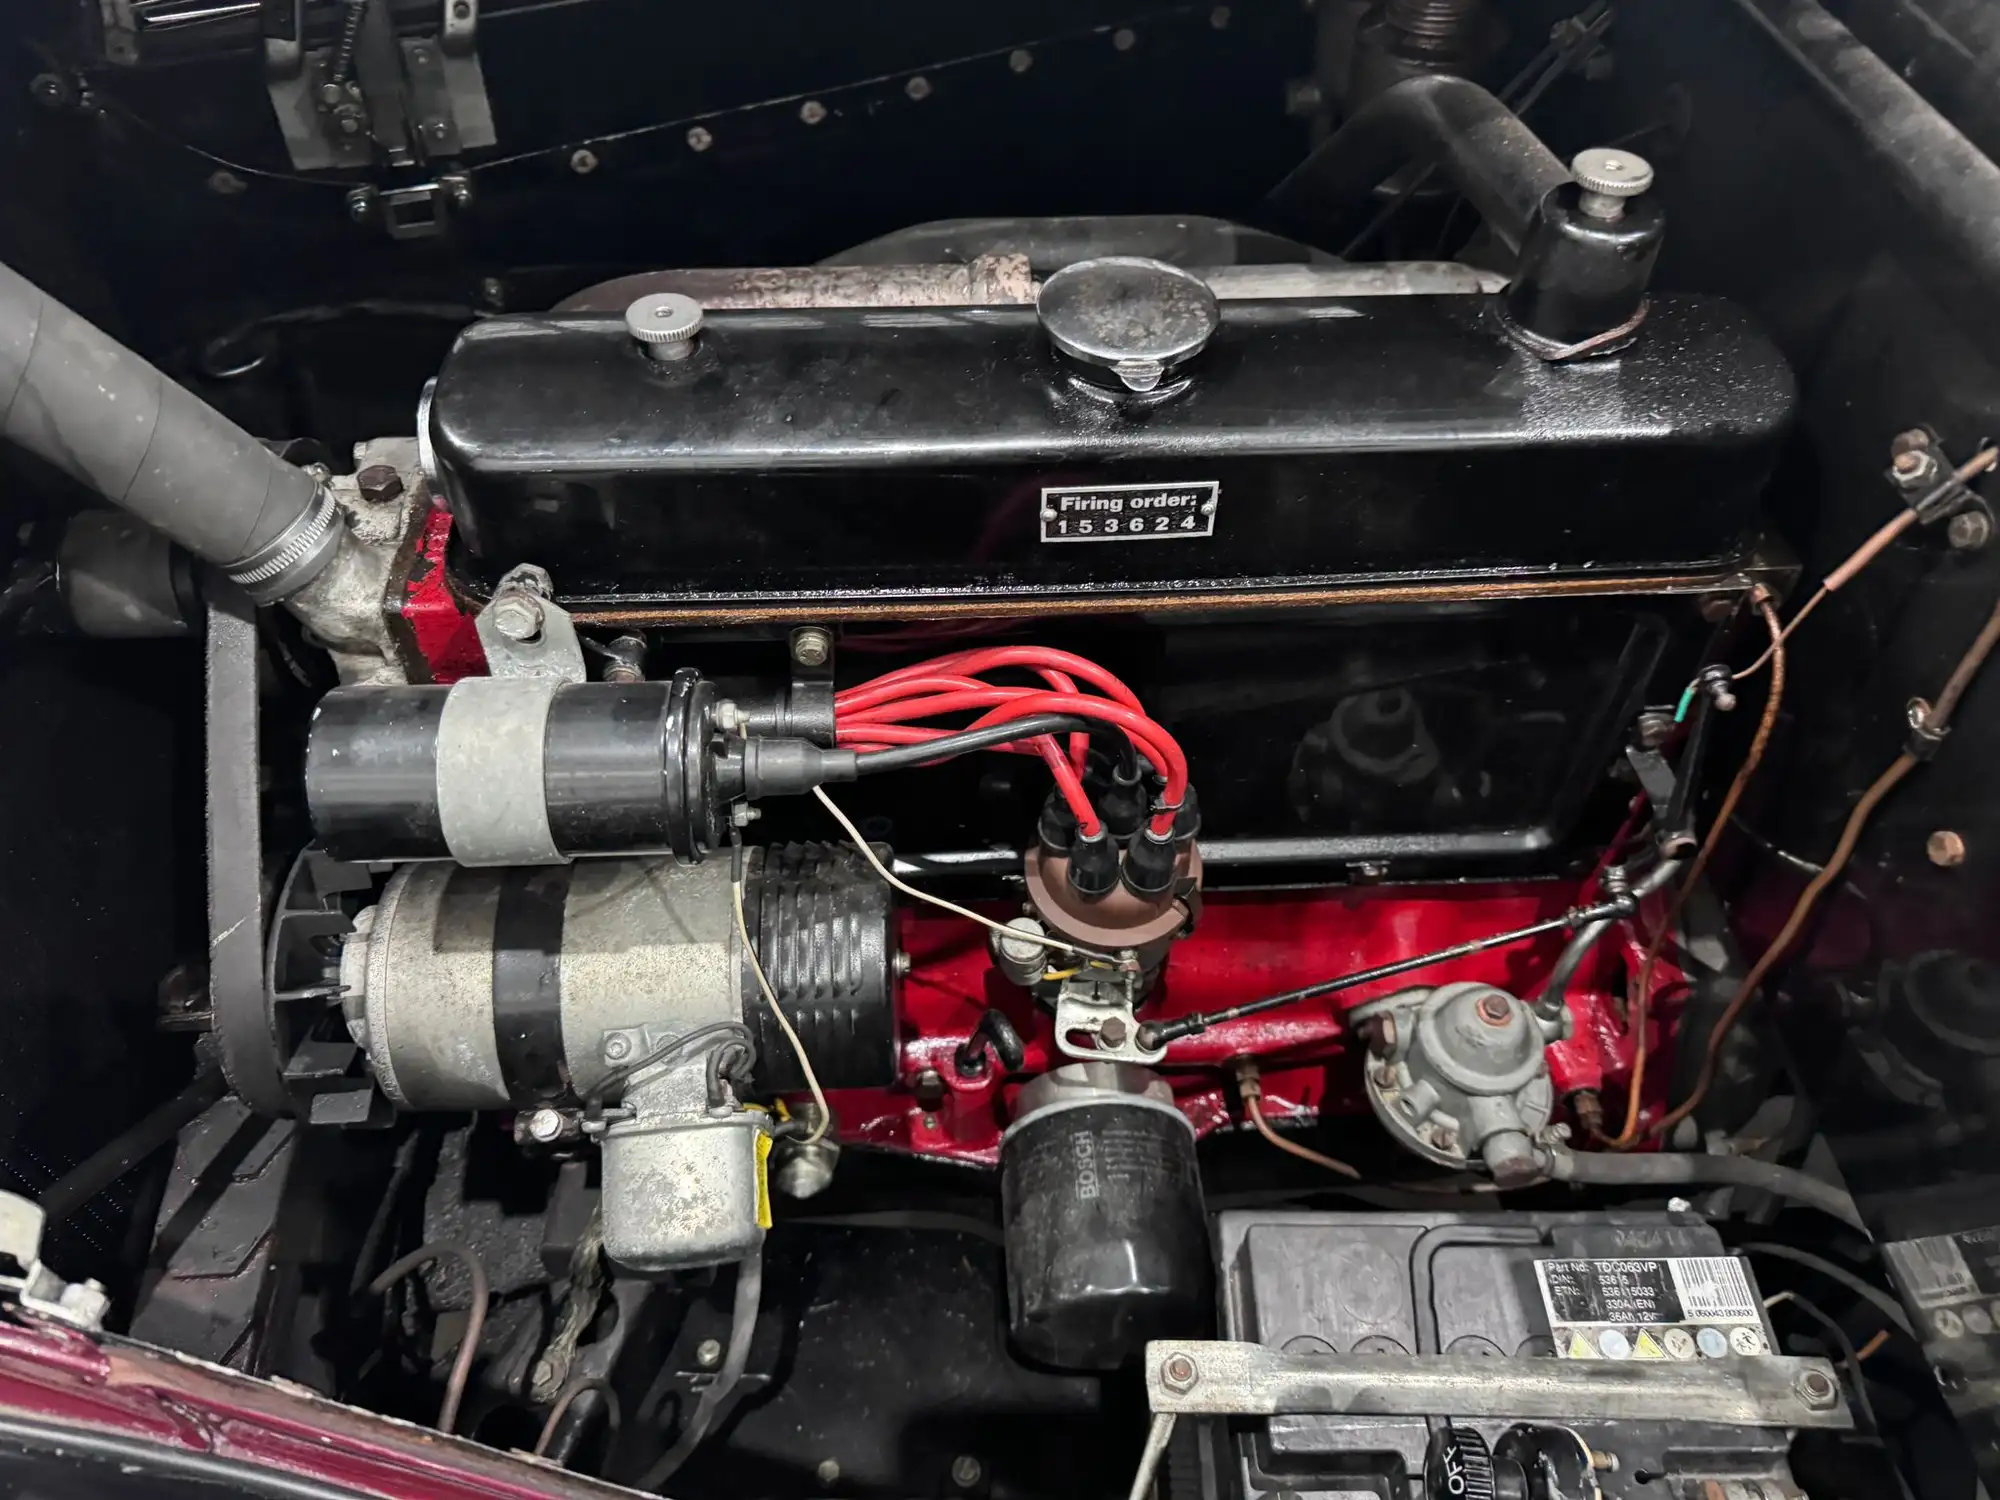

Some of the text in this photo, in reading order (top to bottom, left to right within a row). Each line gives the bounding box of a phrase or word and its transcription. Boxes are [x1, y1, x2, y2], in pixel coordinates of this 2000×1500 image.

[1060, 493, 1197, 512] Firing order:
[1058, 515, 1196, 534] 1 5 3 6 2 4
[1074, 1130, 1097, 1199] BOSCH
[1594, 1261, 1657, 1272] TDC063VP
[1442, 1446, 1465, 1495] OFF
